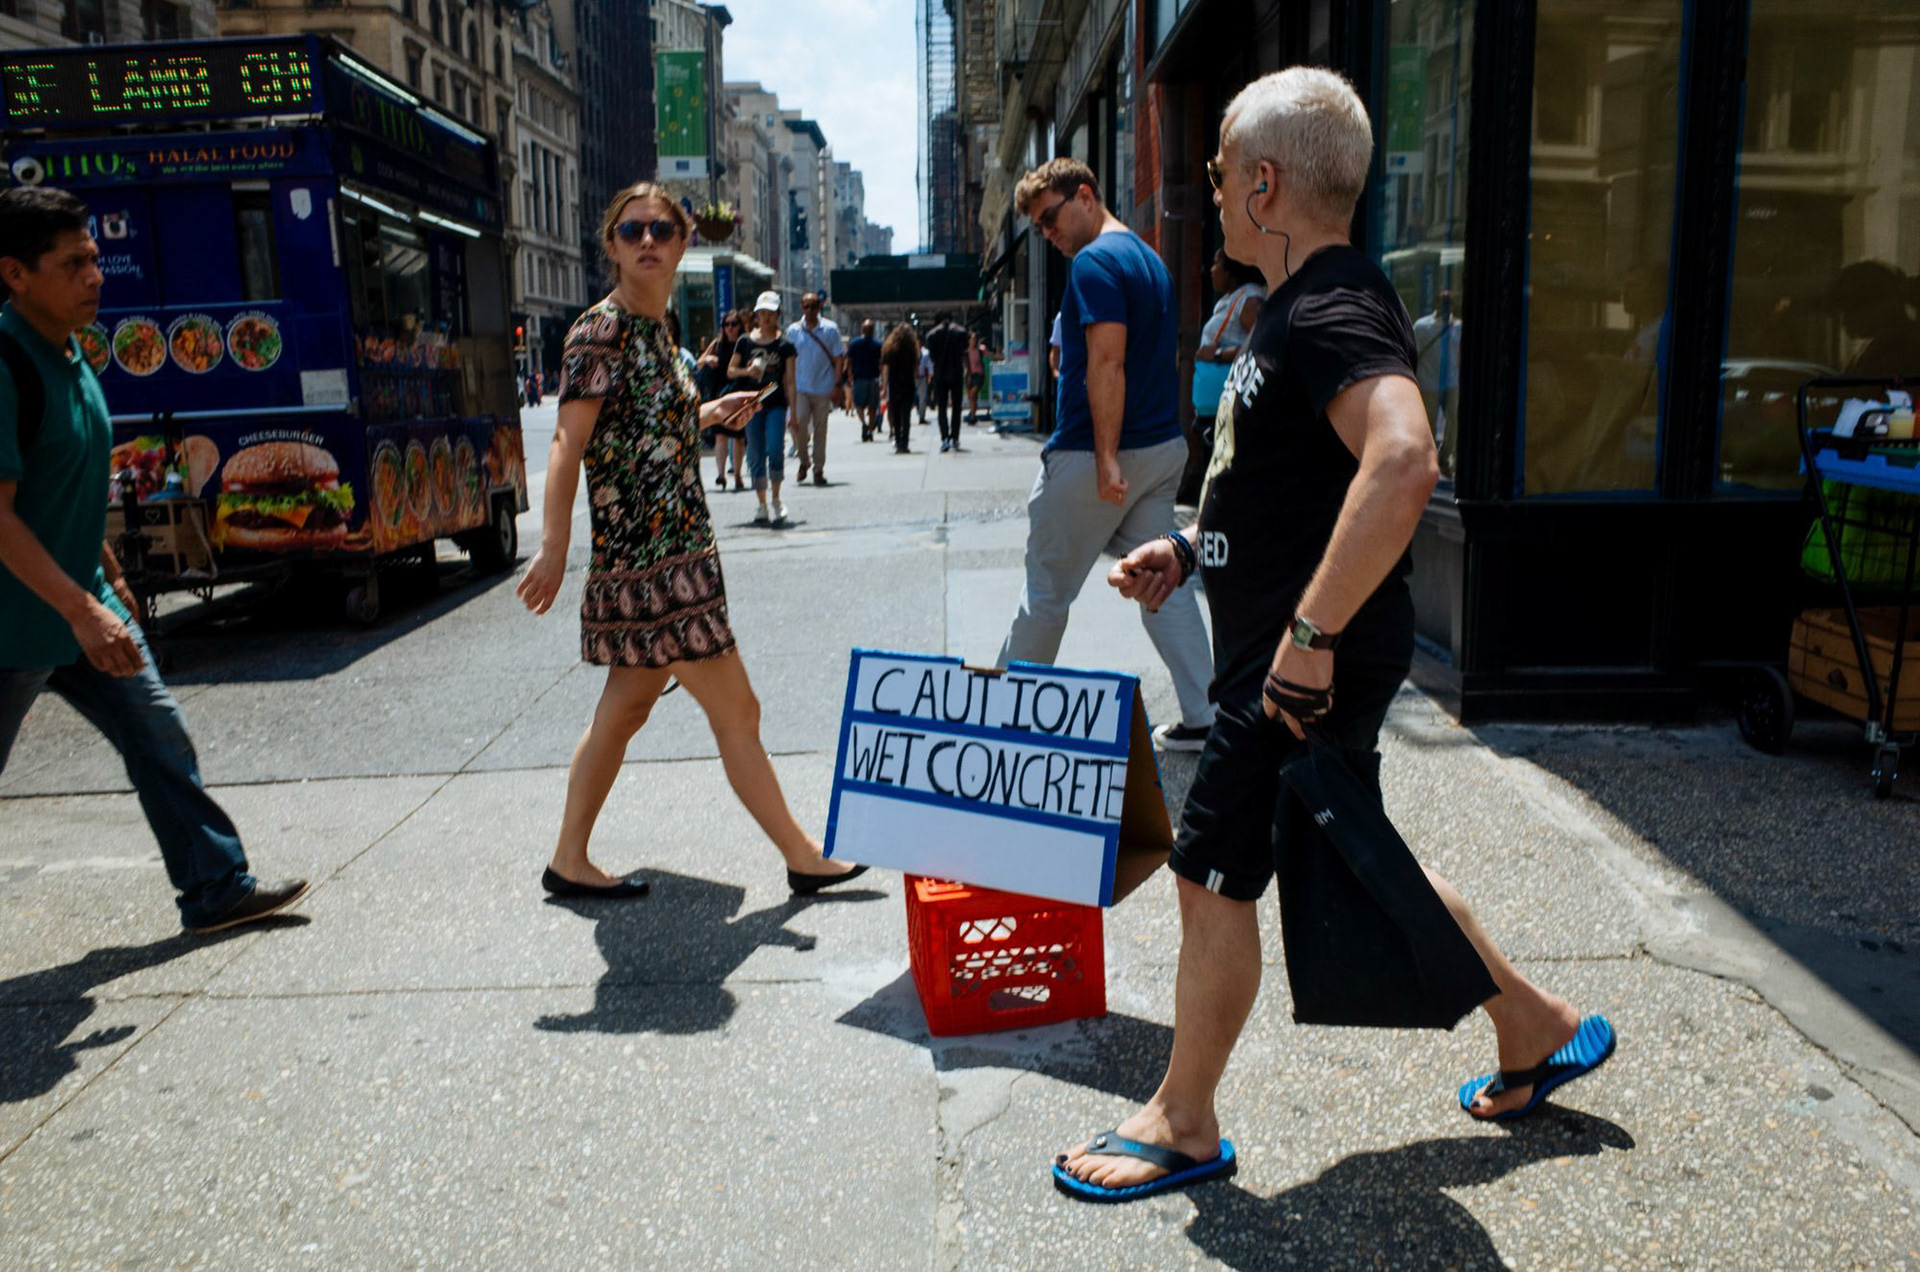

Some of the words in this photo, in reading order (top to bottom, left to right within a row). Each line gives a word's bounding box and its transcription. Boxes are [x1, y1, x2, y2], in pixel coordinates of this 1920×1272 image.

[88, 57, 211, 112] LAMB
[149, 146, 223, 164] HALAL
[229, 143, 294, 161] FOOD
[237, 428, 325, 447] CHEESEBURGER
[871, 667, 1105, 738] CAUTION
[852, 725, 926, 786] WET
[927, 739, 1128, 820] CONCRETE
